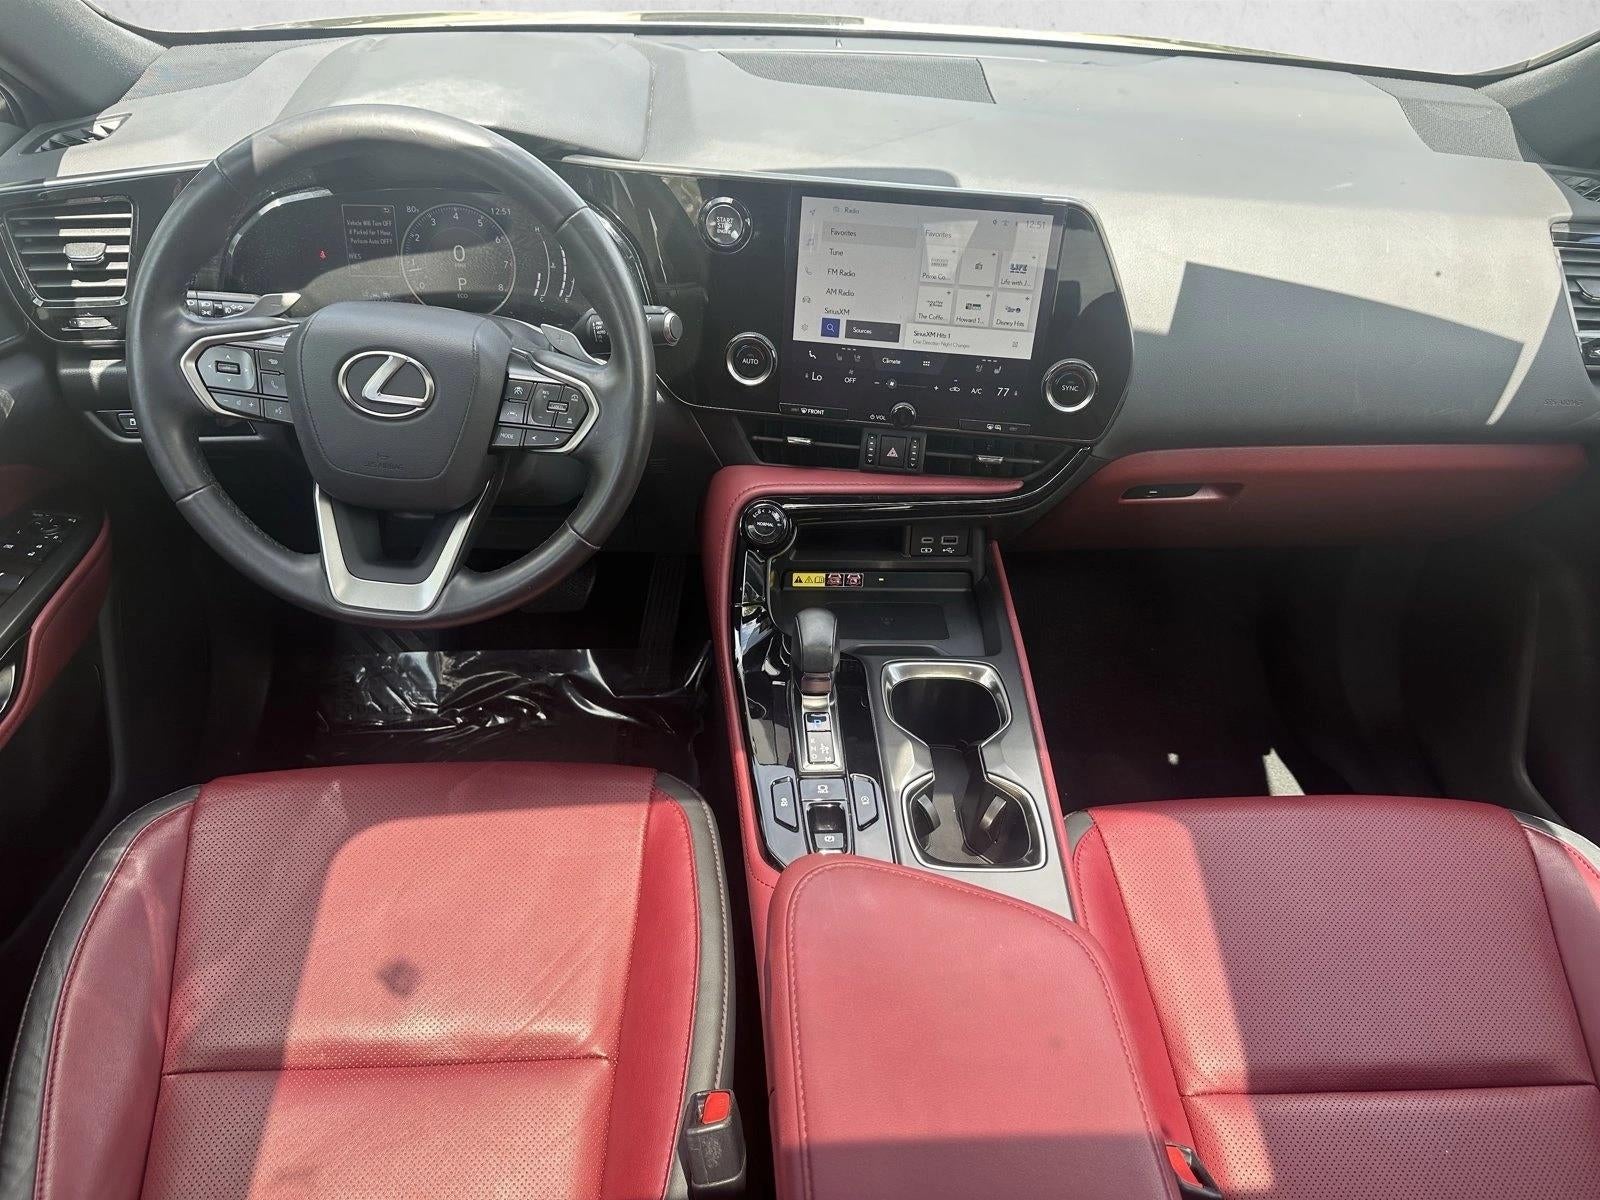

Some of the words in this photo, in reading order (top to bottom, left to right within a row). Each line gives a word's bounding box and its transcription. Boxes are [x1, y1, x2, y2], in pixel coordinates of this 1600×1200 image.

[844, 206, 860, 214] Radio
[453, 212, 459, 220] 4
[716, 216, 733, 224] START
[431, 218, 436, 226] 3
[477, 219, 483, 227] 5
[1026, 220, 1046, 230] 12:51
[830, 227, 857, 237] Favorites
[925, 229, 952, 238] Favorites
[415, 233, 420, 242] 2
[495, 236, 501, 244] 6
[453, 244, 465, 262] 0
[829, 247, 844, 256] Tune
[827, 267, 838, 276] FM
[839, 268, 856, 277] Radio
[458, 277, 467, 291] P
[1000, 278, 1010, 286] Life
[825, 288, 837, 296] AM
[838, 288, 855, 297] Radio
[824, 307, 850, 316] SiriusXM
[918, 312, 928, 320] The
[956, 315, 976, 324] Howard
[996, 318, 1013, 328] Disney
[1013, 320, 1025, 328] Hits
[852, 326, 873, 335] Sources
[913, 330, 936, 338] SiriusXM
[742, 357, 759, 365] AUTO
[882, 357, 901, 365] Climate
[811, 371, 823, 382] Lo
[844, 376, 857, 384] OFF
[970, 387, 983, 396] A/C
[997, 387, 1010, 397] 77
[1061, 384, 1079, 392] SYNC
[807, 408, 825, 416] FRONT
[500, 432, 514, 440] MODE
